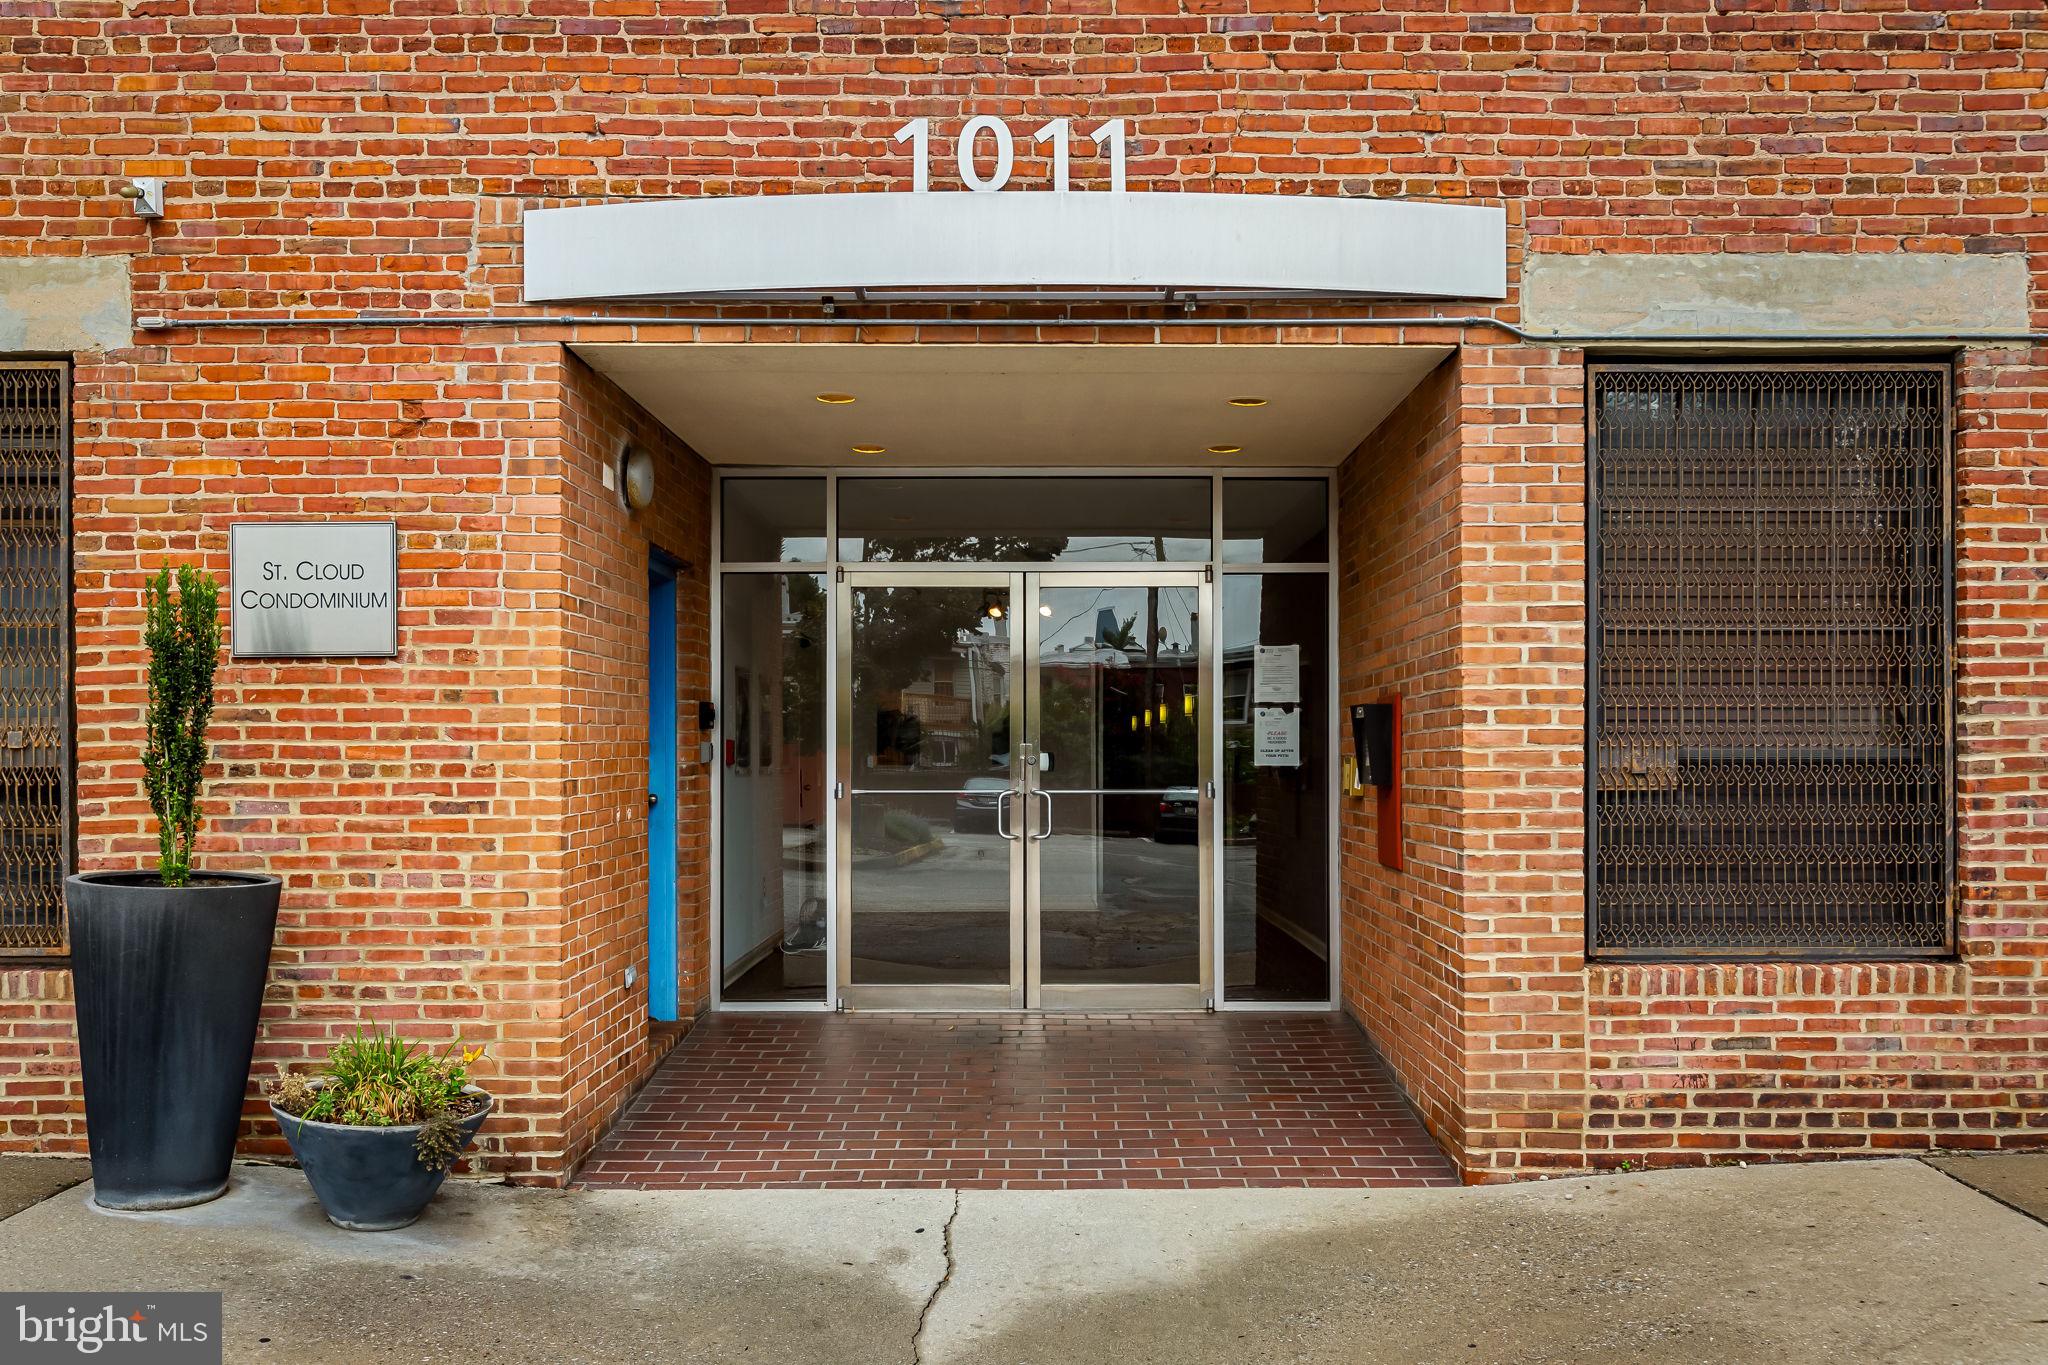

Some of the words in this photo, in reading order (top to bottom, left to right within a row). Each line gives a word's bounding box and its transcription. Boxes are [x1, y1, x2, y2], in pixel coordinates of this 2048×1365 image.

[893, 115, 1126, 192] 1011
[262, 561, 287, 581] ST.
[296, 561, 365, 581] CLOUD
[240, 590, 388, 610] CONDOMINIUM
